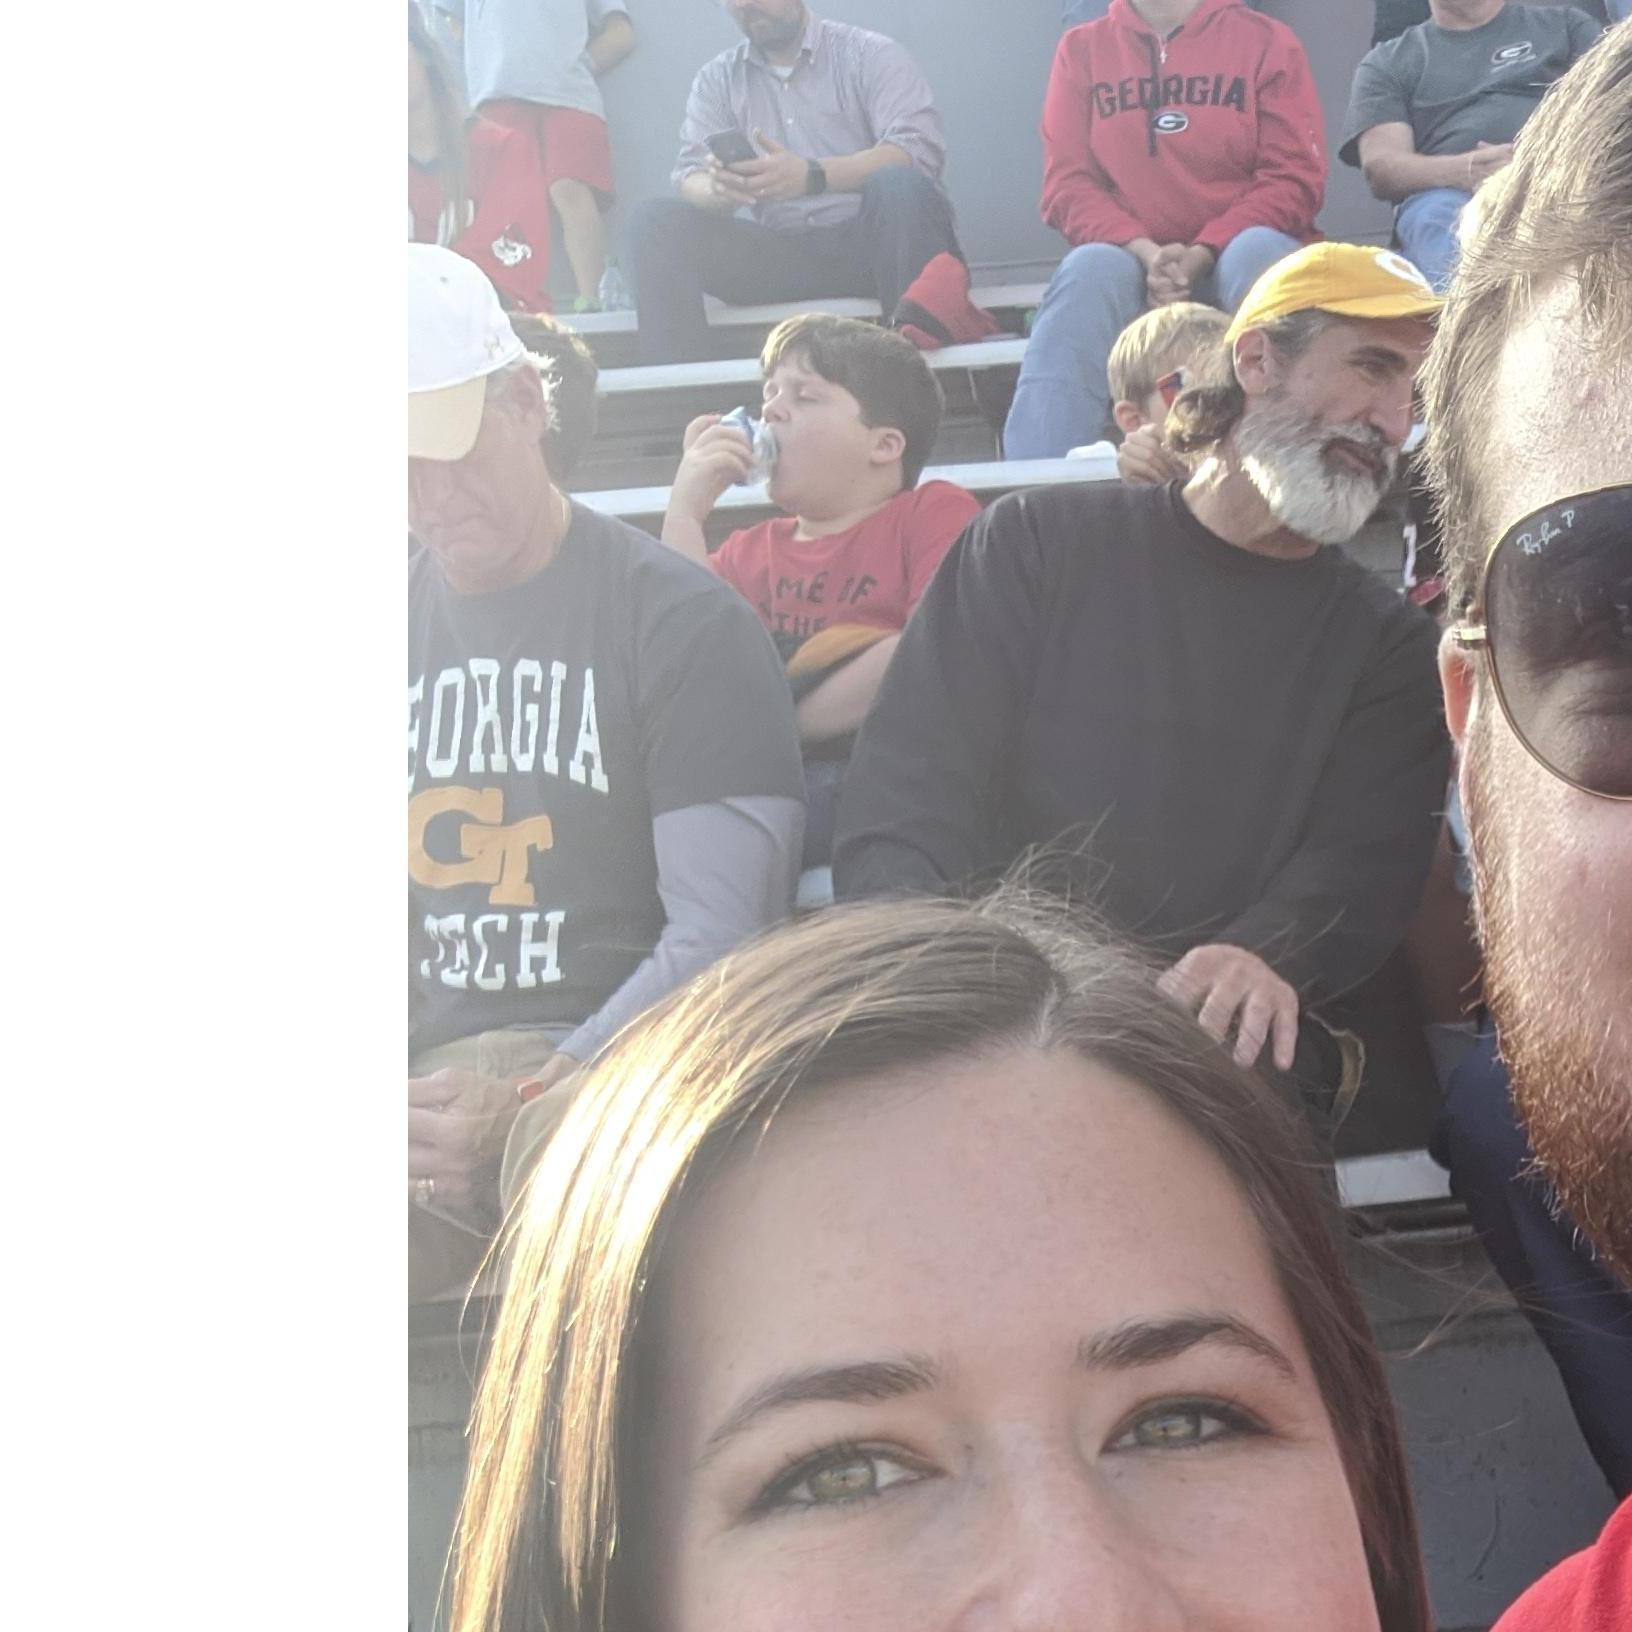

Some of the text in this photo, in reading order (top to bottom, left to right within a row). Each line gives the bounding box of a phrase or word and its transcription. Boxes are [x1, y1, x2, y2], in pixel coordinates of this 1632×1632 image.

[1093, 74, 1246, 118] GEORGIA
[1154, 112, 1188, 132] G
[776, 570, 879, 605] ME IF
[408, 785, 553, 906] GT
